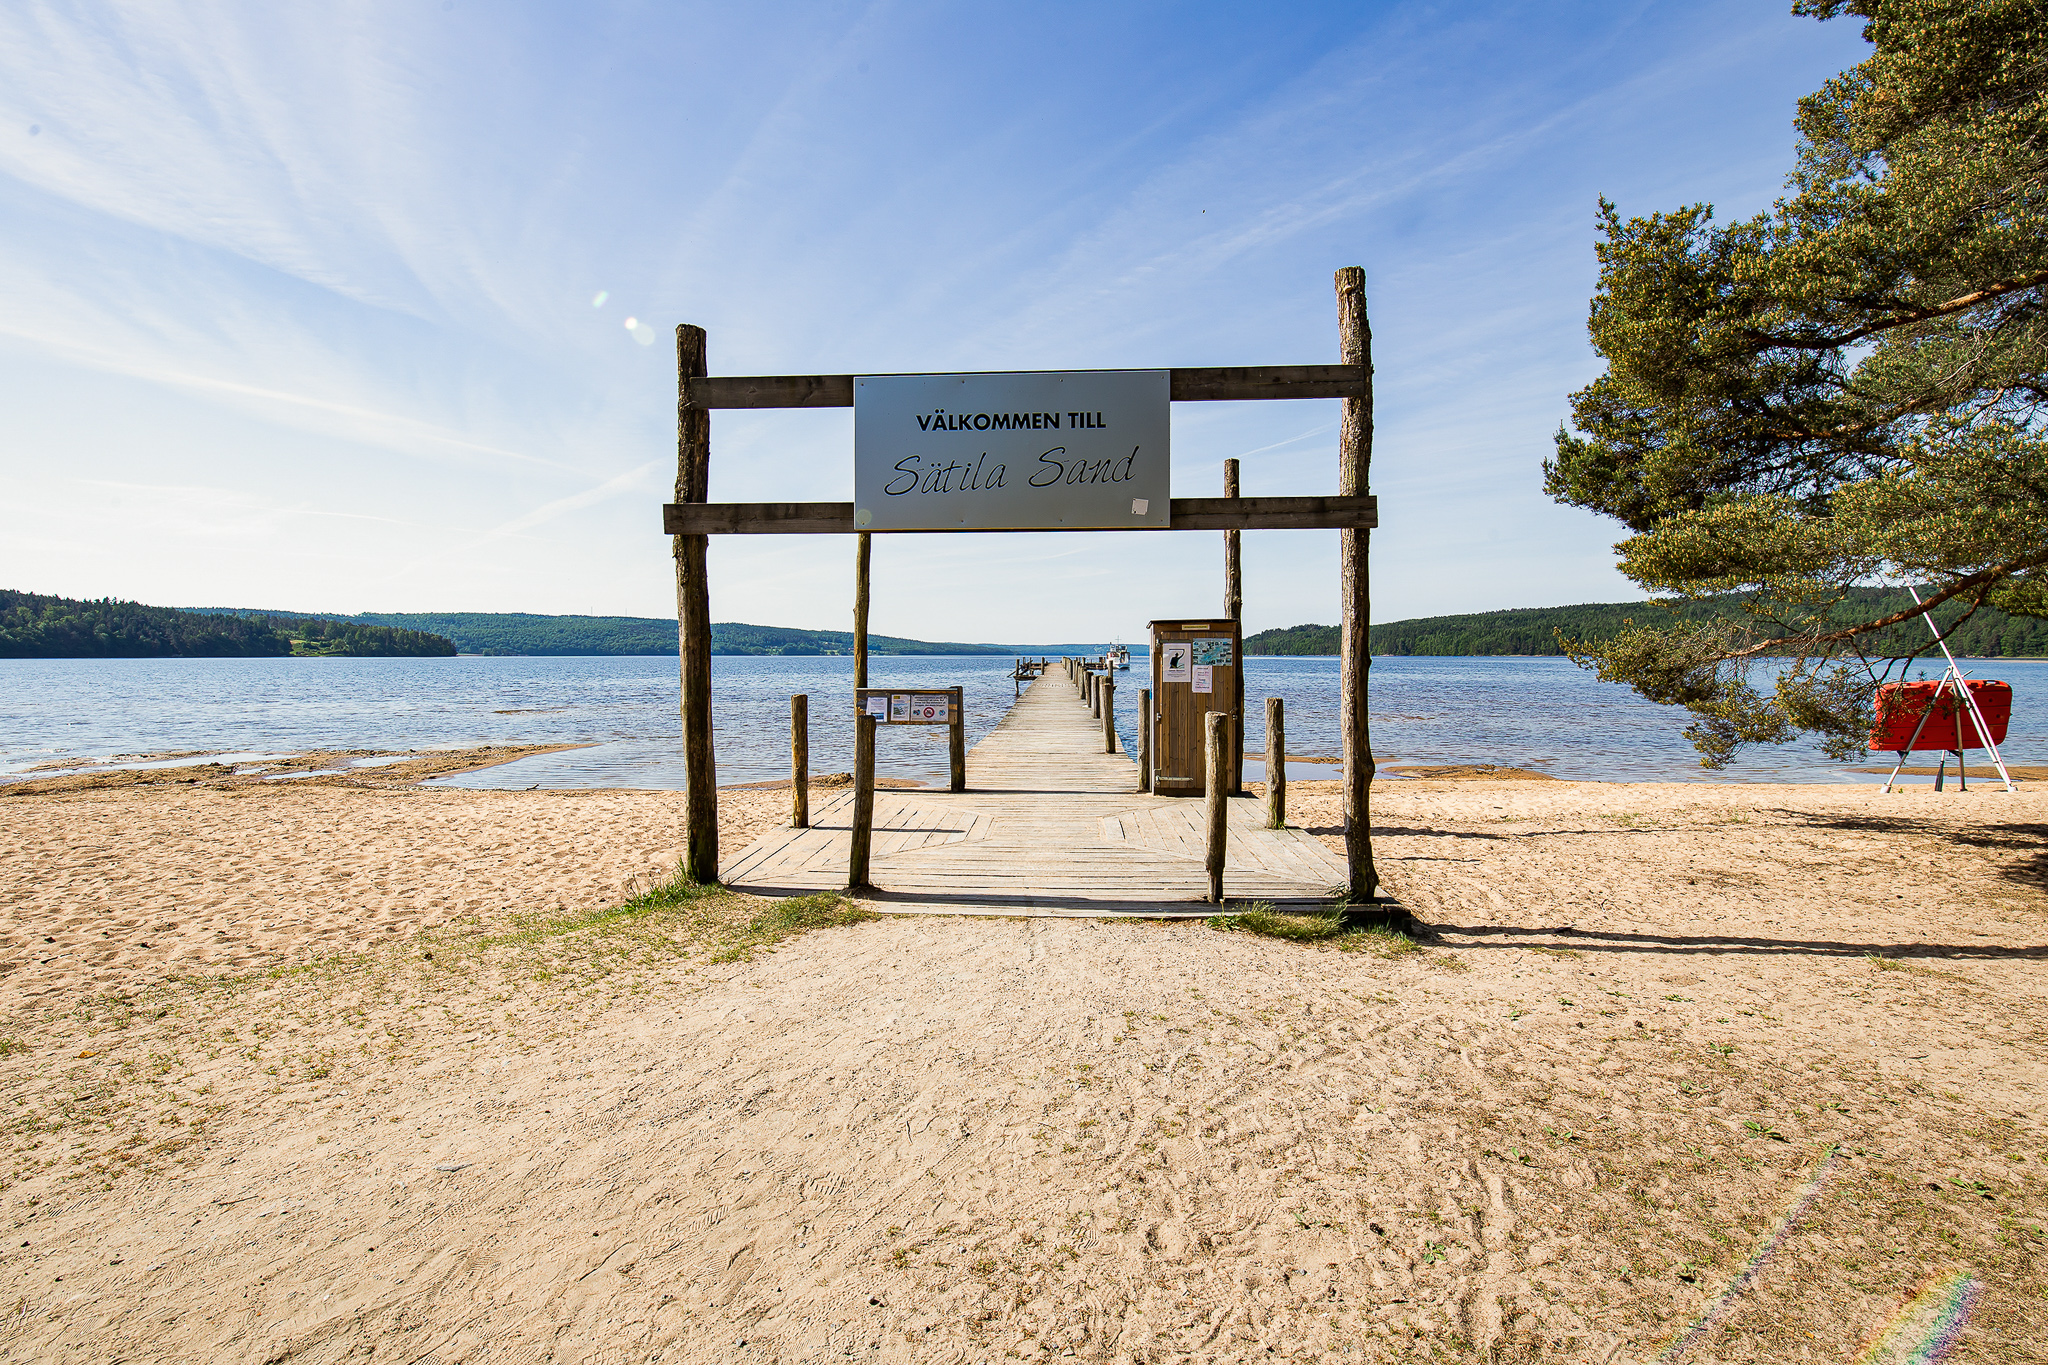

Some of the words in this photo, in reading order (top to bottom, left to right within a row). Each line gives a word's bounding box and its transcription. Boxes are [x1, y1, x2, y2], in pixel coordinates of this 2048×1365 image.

[915, 408, 1060, 431] VÄLKOMMEN
[1067, 411, 1107, 429] TILL
[884, 452, 1009, 495] Sätila
[1028, 445, 1140, 487] Sand
